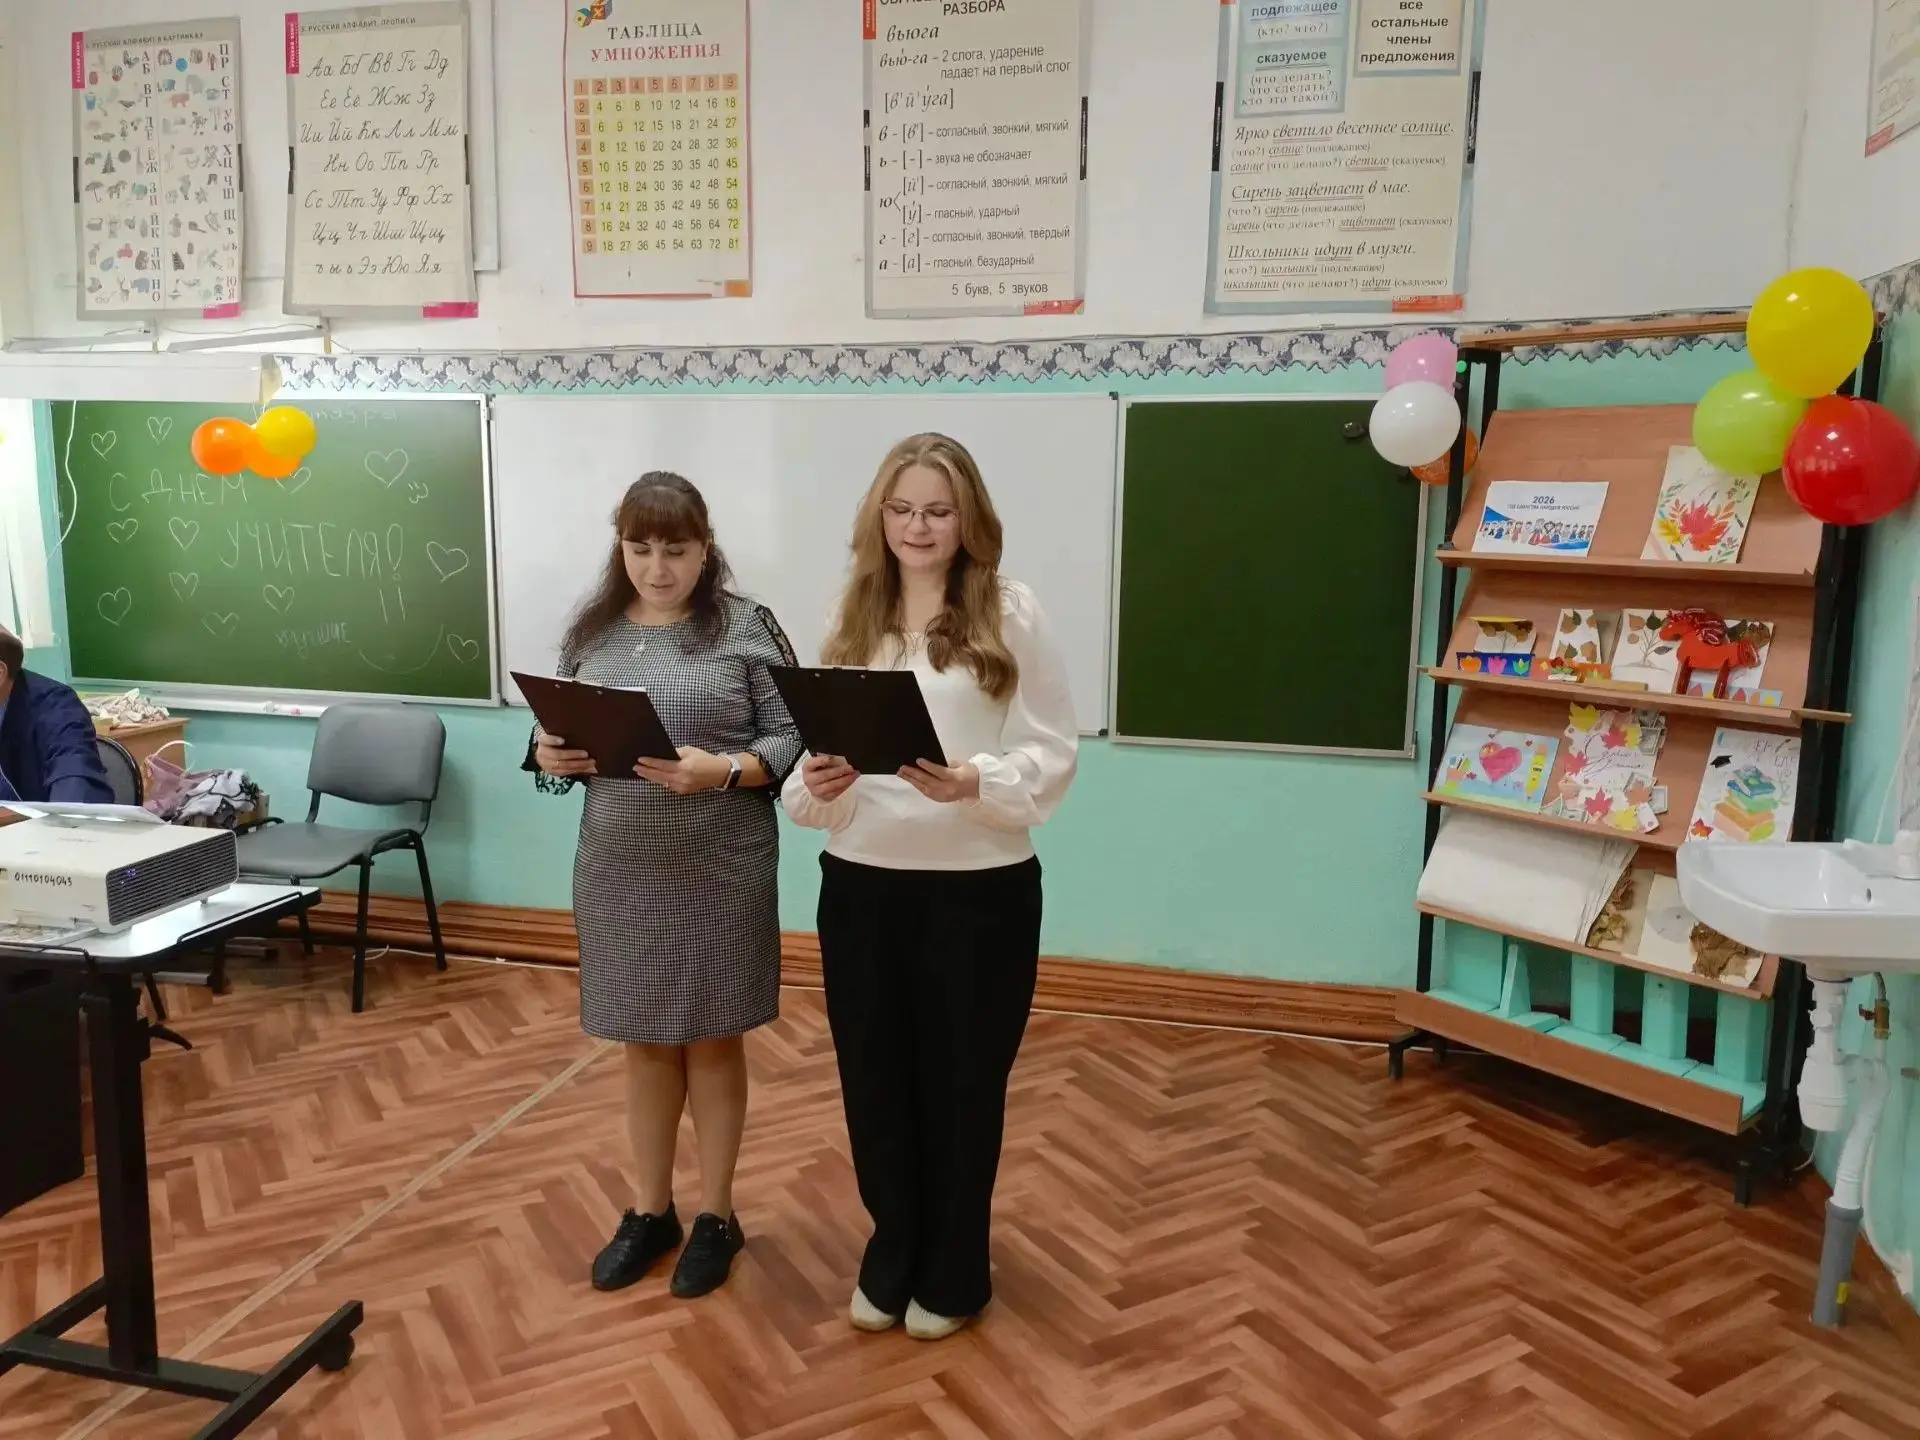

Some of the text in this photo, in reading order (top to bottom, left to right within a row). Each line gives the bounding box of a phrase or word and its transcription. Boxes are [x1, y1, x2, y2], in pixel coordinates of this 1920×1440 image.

[943, 0, 1005, 16] РАЗБОРА
[1252, 1, 1338, 17] подлежащее
[1399, 1, 1423, 10] все
[1371, 17, 1449, 28] остальные
[607, 22, 702, 40] ТАБЛИЦА
[886, 24, 939, 42] вьюга
[1386, 35, 1432, 45] члены
[591, 43, 721, 62] УМНОЖЕНИЯ
[942, 49, 949, 62] 2
[951, 50, 985, 62] слога,
[989, 46, 1044, 62] ударение
[1256, 51, 1327, 64] сказуемое
[1360, 52, 1455, 64] предложения
[941, 60, 1072, 80] падает на первый слог
[651, 100, 662, 111] 10
[670, 99, 681, 110] 12
[688, 99, 699, 109] 14
[707, 98, 718, 109] 16
[725, 97, 736, 108] 18
[879, 125, 888, 141] в
[1234, 121, 1454, 144] Ярко светило весеннее солнце.
[935, 153, 960, 166] звука
[963, 153, 975, 163] не
[976, 149, 1032, 163] обозначает
[1035, 172, 1068, 185] мягкий
[1231, 180, 1411, 202] Сирень зацветает в мае.
[979, 204, 1020, 219] ударный
[603, 240, 614, 251] 18
[620, 240, 631, 251] 27
[637, 240, 649, 250] 36
[655, 239, 666, 250] 45
[673, 239, 684, 249] 54
[691, 239, 702, 249] 63
[709, 239, 721, 249] 72
[728, 238, 739, 249] 81
[1228, 245, 1309, 258] Школьники
[1314, 243, 1353, 260] идут
[1356, 241, 1366, 255] в
[977, 254, 1035, 269] безударный
[1261, 264, 1318, 274] школьники
[951, 281, 1049, 298] 5 букв, 5 звуков
[109, 472, 132, 511] С
[1532, 495, 1555, 505] 2026
